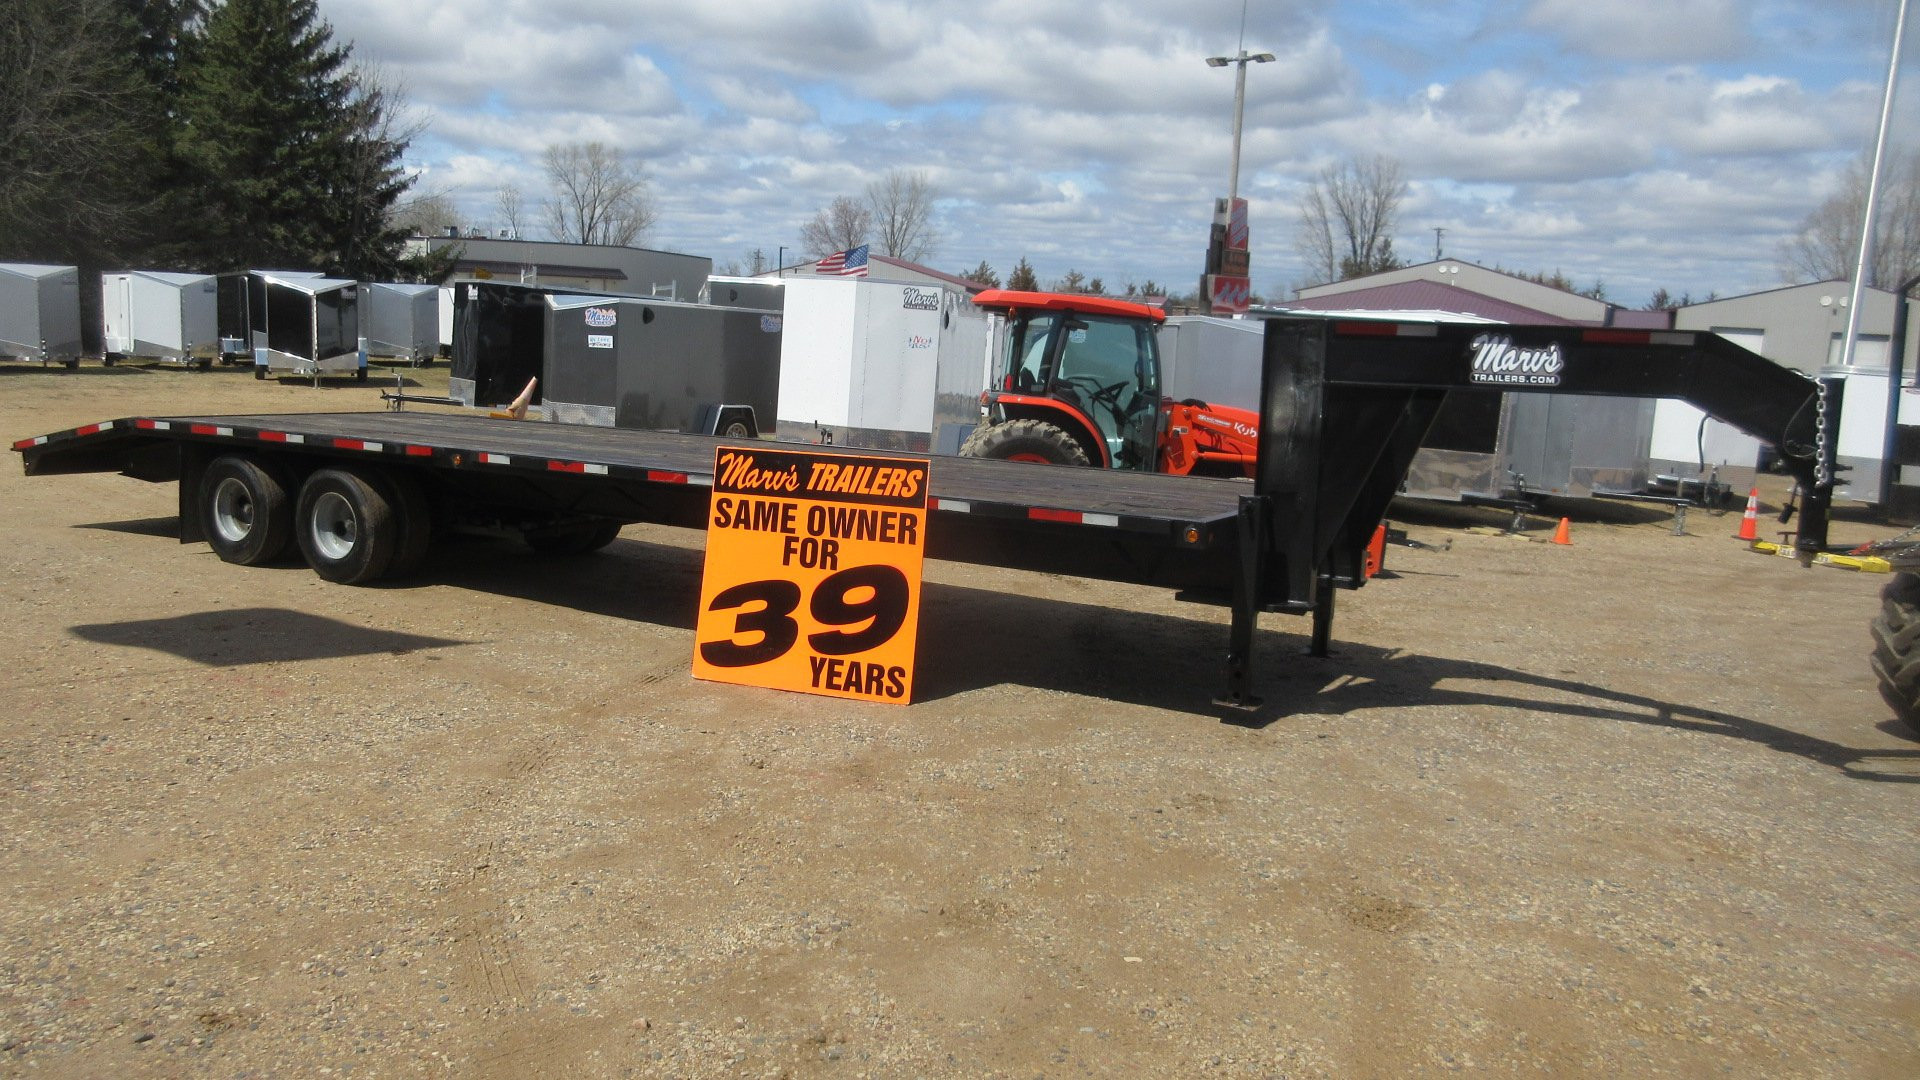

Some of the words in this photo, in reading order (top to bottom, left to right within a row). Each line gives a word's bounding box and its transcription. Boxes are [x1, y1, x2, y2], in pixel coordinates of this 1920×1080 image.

[1473, 334, 1560, 373] Marv's
[1474, 374, 1555, 384] TRAILERS.COM
[719, 452, 799, 492] Marv's
[807, 463, 923, 498] TRAILERS
[714, 498, 798, 534] SAME
[807, 505, 918, 545] OWNER
[782, 536, 840, 571] FOR
[700, 564, 910, 668] 39
[809, 655, 906, 699] YEARS
